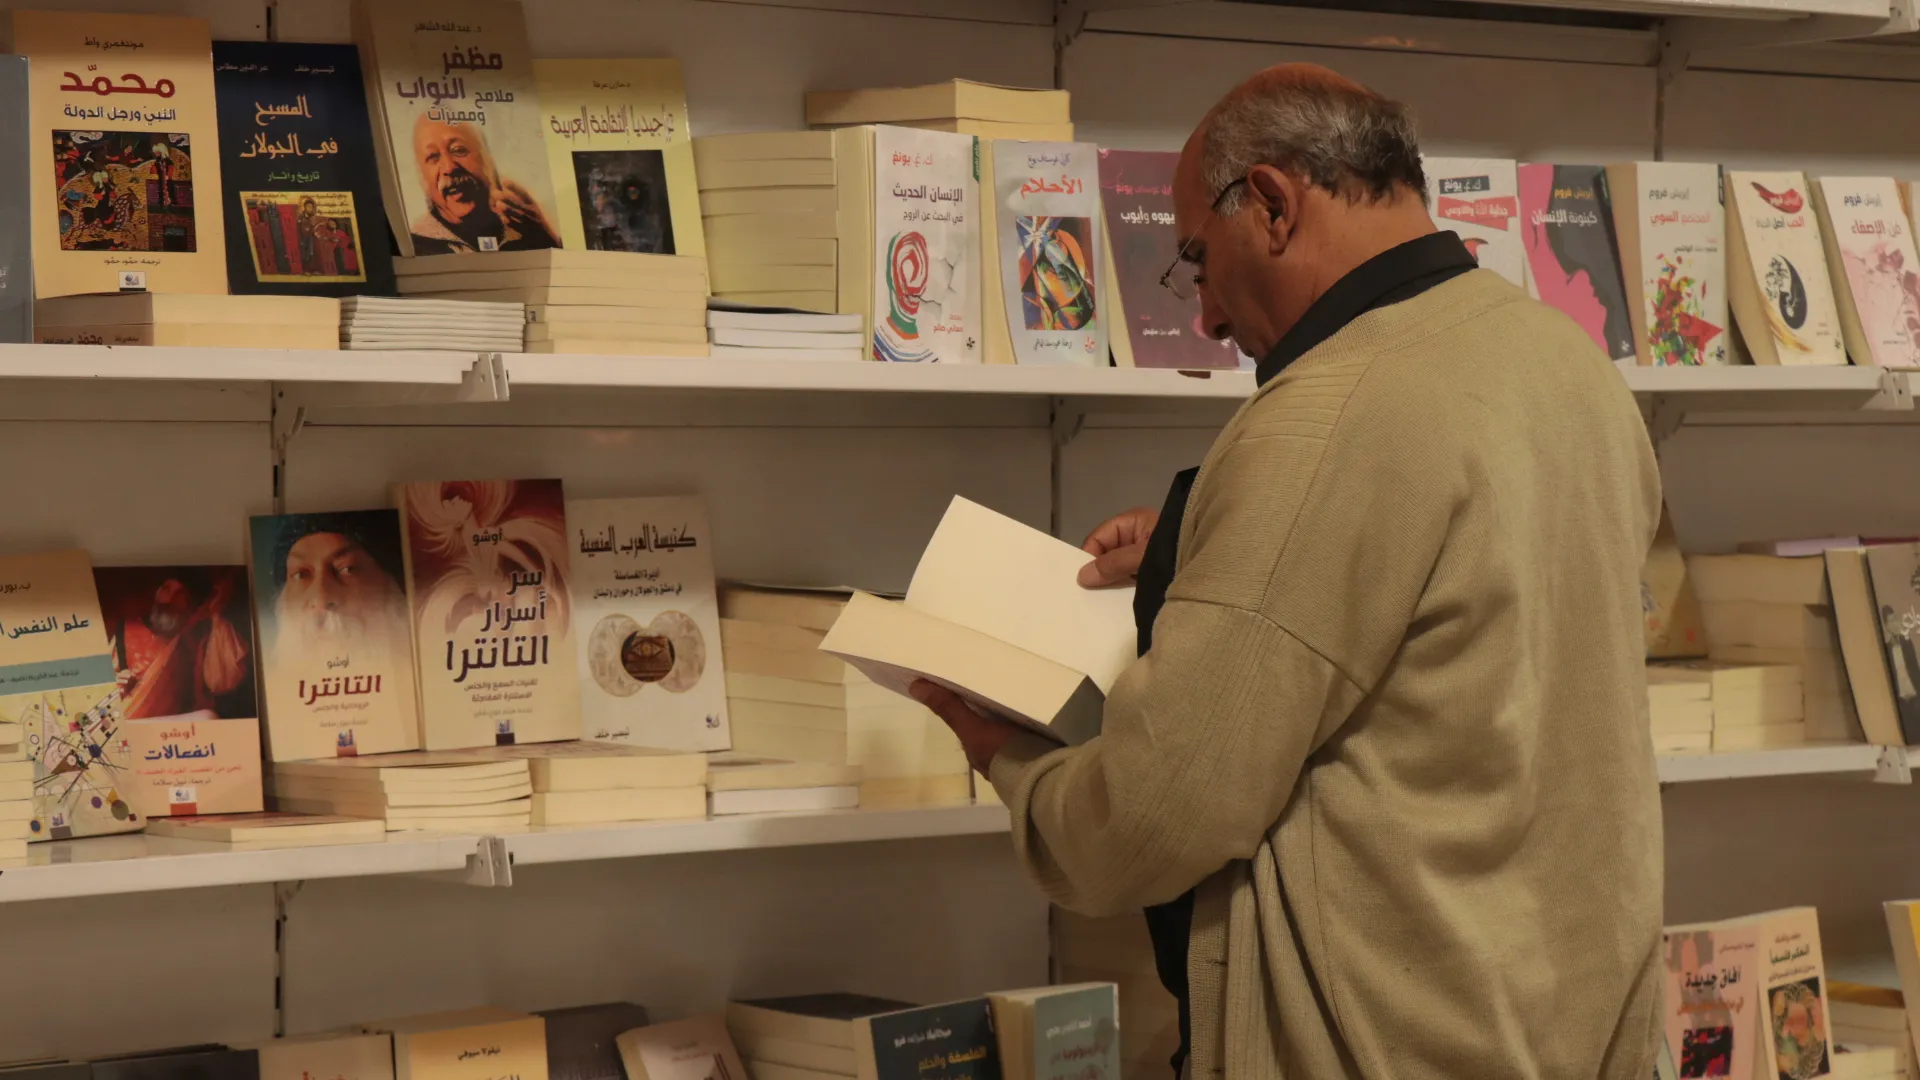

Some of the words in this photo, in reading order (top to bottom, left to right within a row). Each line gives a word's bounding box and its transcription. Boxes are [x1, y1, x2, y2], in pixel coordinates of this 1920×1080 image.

[442, 45, 503, 75] مظفر
[396, 76, 466, 105] النواب
[474, 89, 514, 109] ملامح
[64, 103, 103, 120] الدولة
[107, 106, 141, 122] ورجل
[255, 94, 312, 126] المسيح
[428, 106, 486, 126] ومميزات
[550, 105, 590, 143] العربية
[590, 104, 630, 143] الثقافة
[240, 132, 303, 159] الجولان
[306, 137, 338, 158] في
[893, 151, 911, 166] يونغ
[297, 171, 320, 183] تاريخ
[1021, 174, 1082, 199] الأحلام
[893, 183, 926, 202] الحديث
[929, 186, 963, 206] الإنسان
[903, 208, 919, 222] الروح
[921, 211, 930, 222] عن
[933, 211, 950, 222] البحث
[952, 213, 963, 225] في
[1120, 205, 1150, 224] وأيوب
[1151, 212, 1176, 225] يهوه
[1531, 208, 1568, 227] الإنسان
[1568, 210, 1598, 227] كينونة
[472, 528, 503, 547] أوشو
[579, 523, 619, 557] المنسية
[619, 523, 654, 559] العرب
[653, 522, 697, 552] كنيسة
[507, 570, 543, 595] سر
[480, 591, 546, 632] أسرار
[8, 616, 58, 639] النفس
[63, 613, 89, 632] علم
[446, 635, 549, 683] التانترا
[299, 675, 381, 705] التانترا
[160, 722, 196, 741] أوشو
[144, 742, 215, 761] انفعالات
[1685, 972, 1717, 993] جديدة
[948, 1045, 987, 1064] الفلسفة
